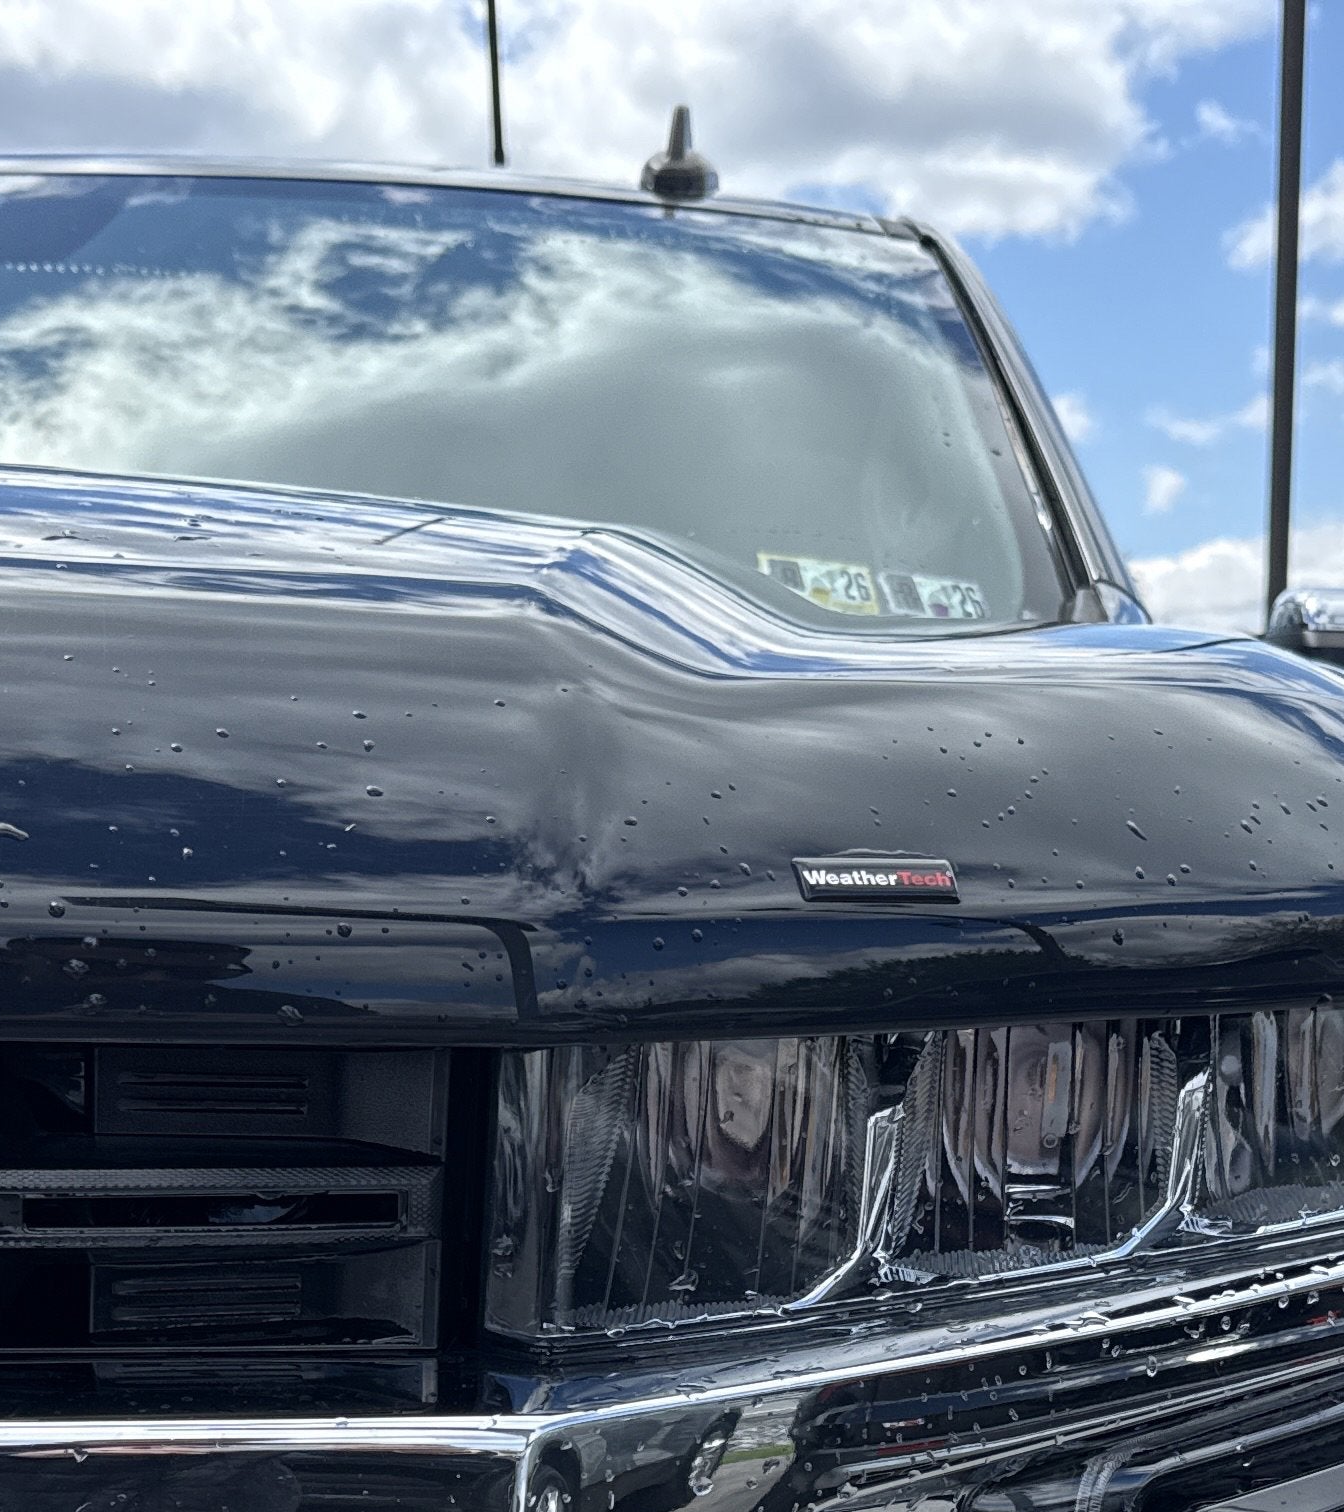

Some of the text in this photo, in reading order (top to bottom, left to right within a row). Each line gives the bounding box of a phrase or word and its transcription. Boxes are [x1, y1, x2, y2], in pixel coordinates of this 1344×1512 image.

[840, 569, 871, 602] 26
[951, 584, 985, 618] 26
[802, 869, 952, 887] WeatherTech
